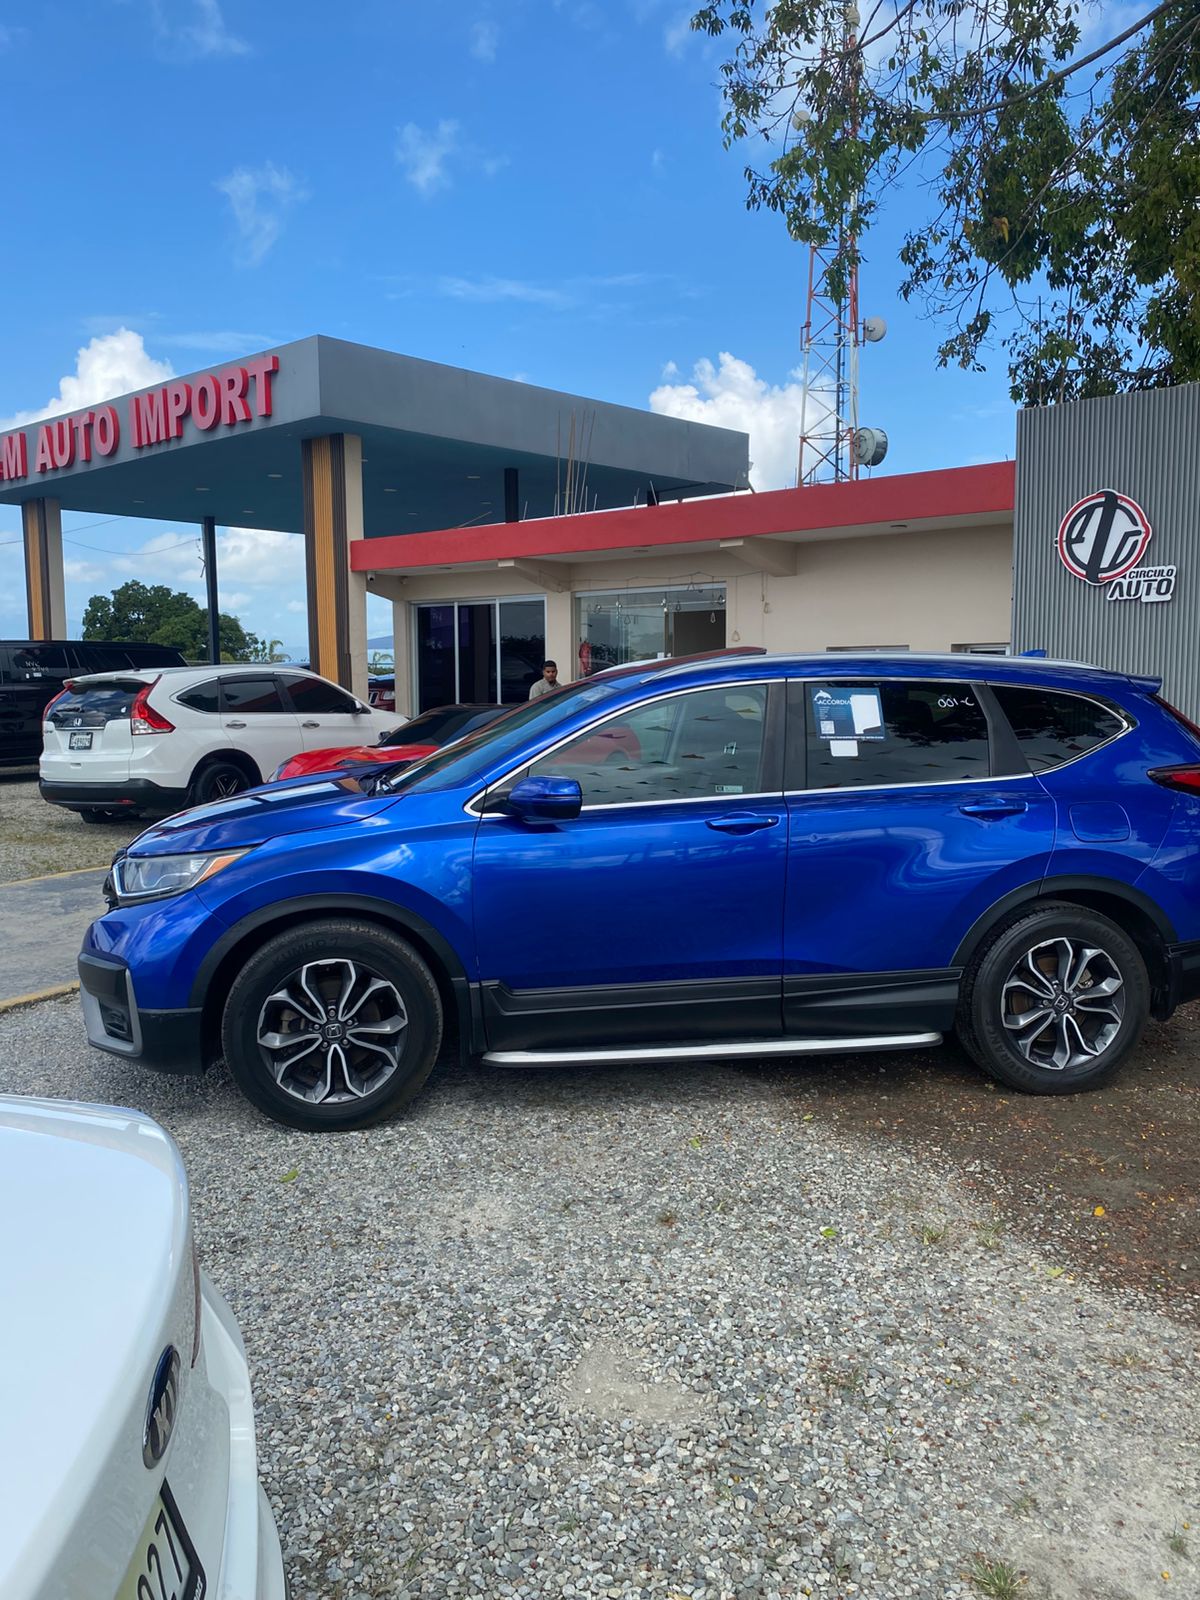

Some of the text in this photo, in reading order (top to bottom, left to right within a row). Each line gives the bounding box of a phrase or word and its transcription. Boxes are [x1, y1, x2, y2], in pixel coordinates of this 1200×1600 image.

[0, 355, 279, 480] M AUTO IMPORT
[1109, 578, 1173, 599] AUTO
[1128, 568, 1174, 580] CIRCULO
[273, 939, 327, 964] KUMHO
[1095, 926, 1143, 990] GOODYEAR
[985, 1017, 1038, 1081] ASSURANCE
